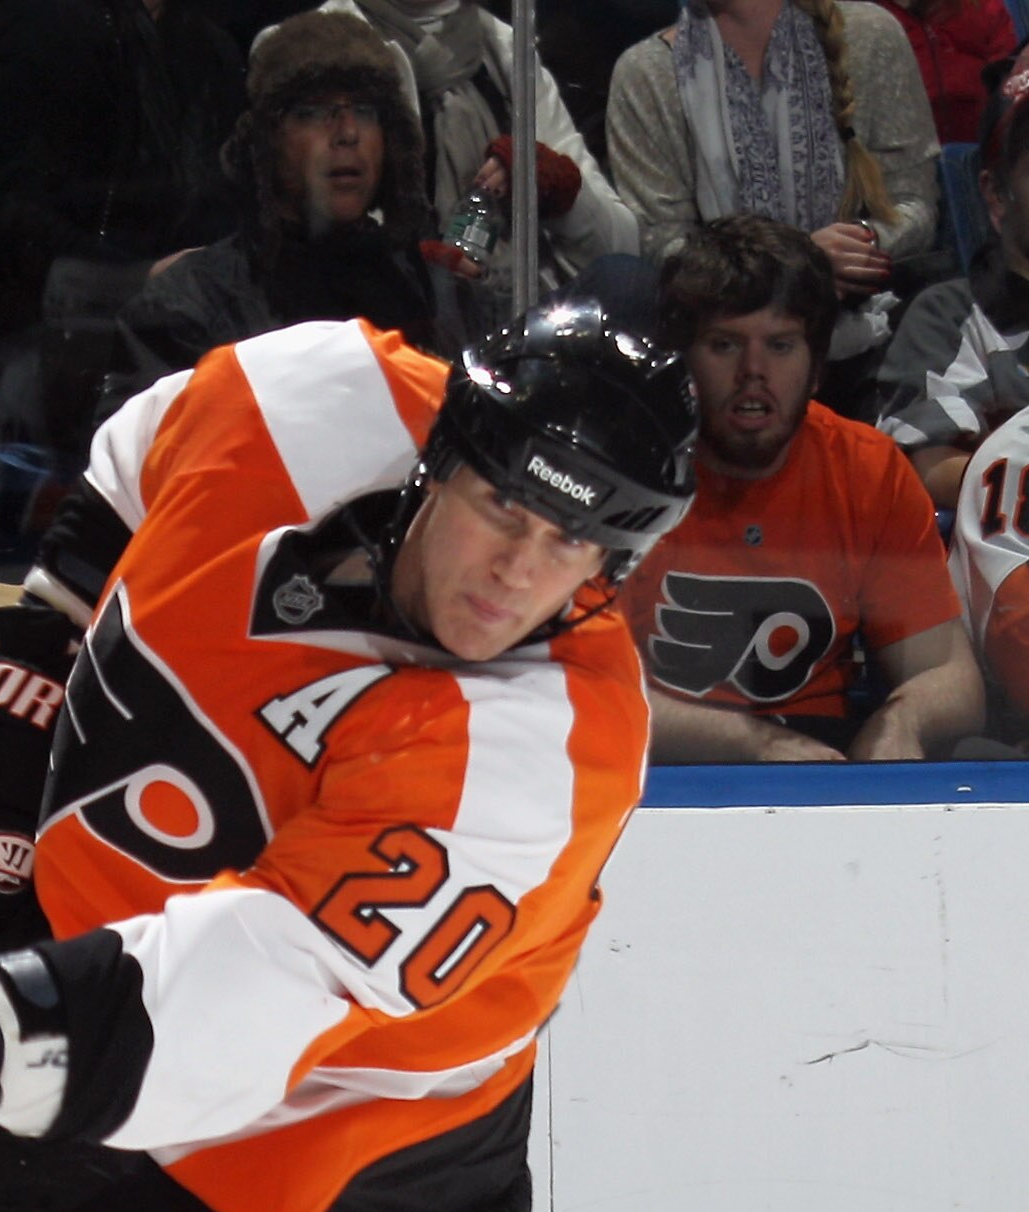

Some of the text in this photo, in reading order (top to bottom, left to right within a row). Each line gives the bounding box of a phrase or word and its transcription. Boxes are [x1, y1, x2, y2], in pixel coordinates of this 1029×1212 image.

[527, 455, 597, 507] Reebok
[254, 662, 392, 771] A
[309, 823, 517, 1011] 20
